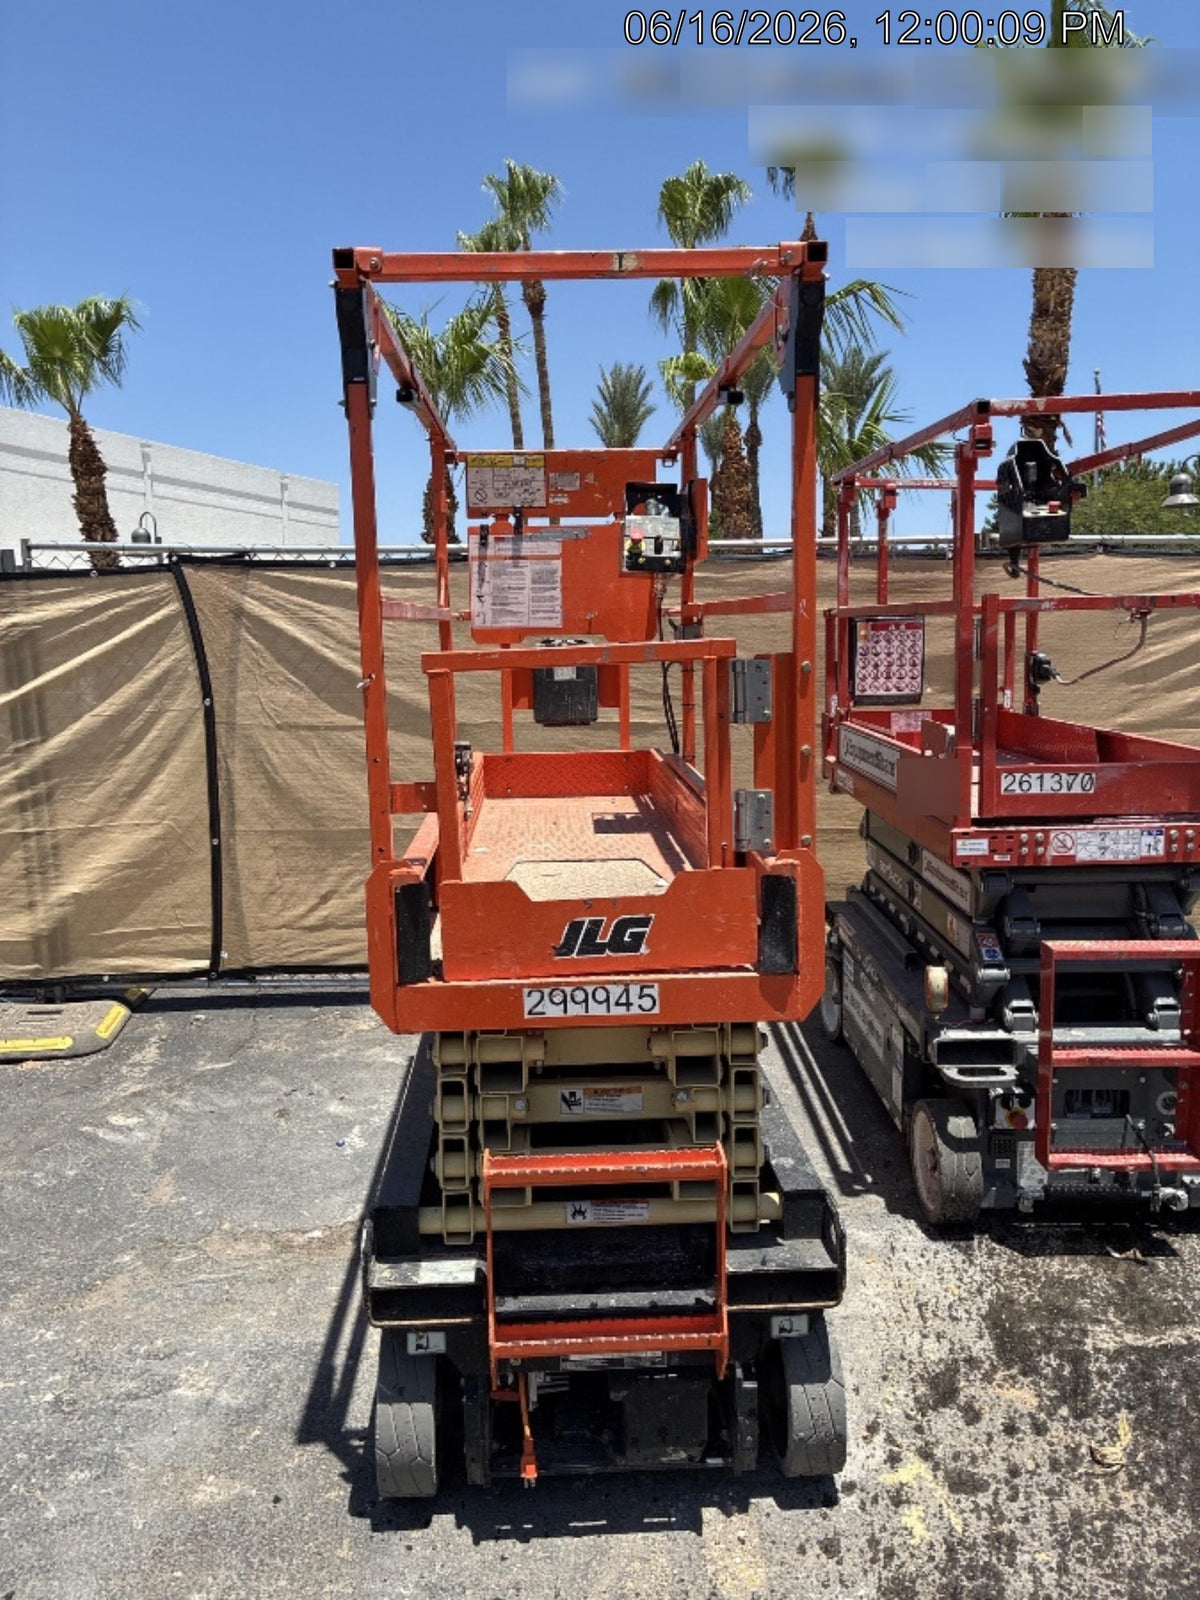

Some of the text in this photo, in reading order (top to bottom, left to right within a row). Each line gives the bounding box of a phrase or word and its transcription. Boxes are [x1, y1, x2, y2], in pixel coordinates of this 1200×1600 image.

[1003, 772, 1094, 792] 261370
[552, 914, 655, 958] JLG
[527, 984, 657, 1016] 299945
